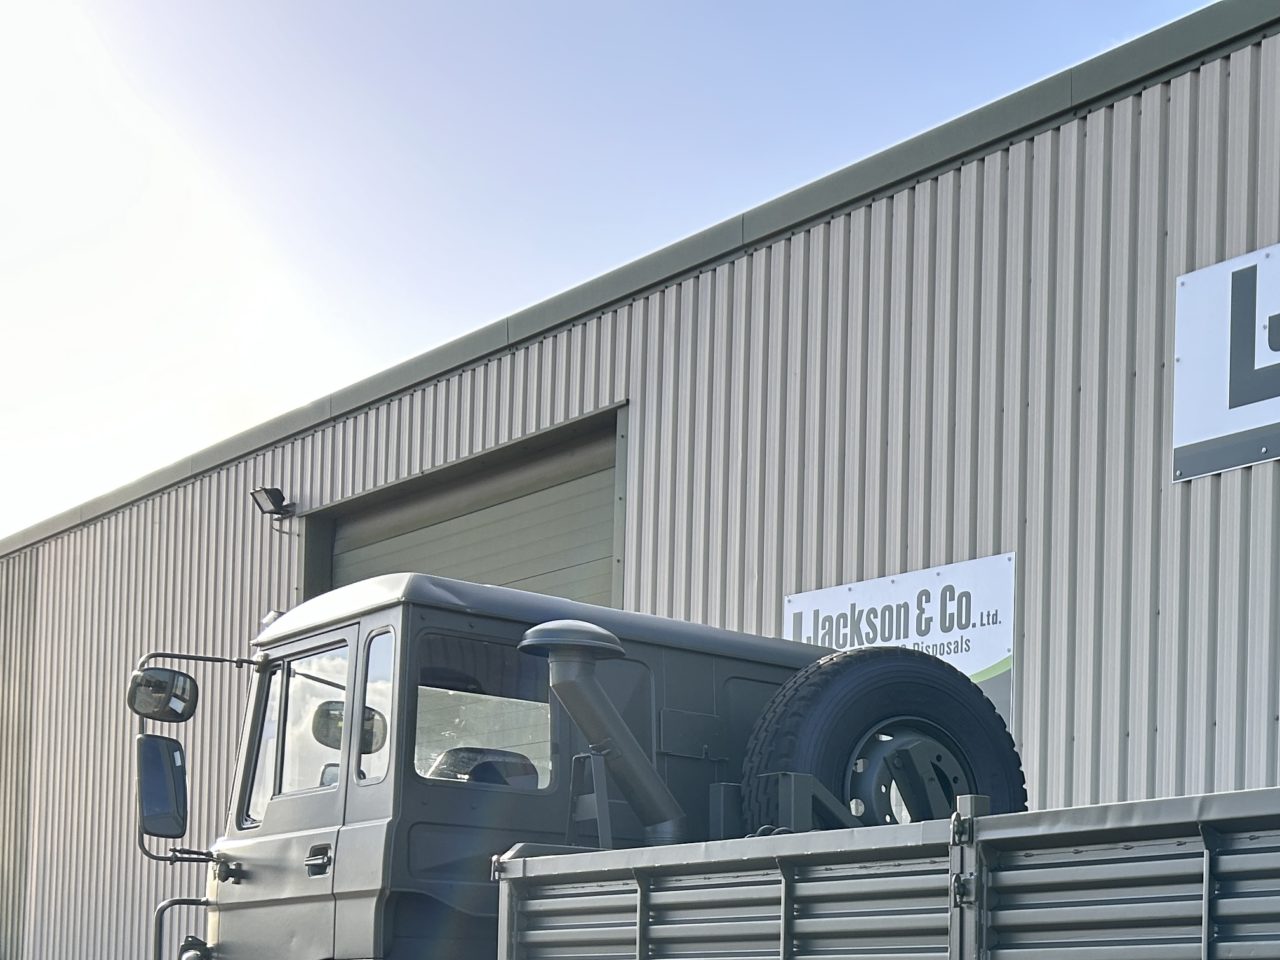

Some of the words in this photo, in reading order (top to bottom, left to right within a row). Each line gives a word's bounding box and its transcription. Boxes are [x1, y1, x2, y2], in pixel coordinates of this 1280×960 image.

[916, 589, 933, 637] &
[939, 584, 976, 633] Co.
[980, 609, 1002, 627] Ltd.
